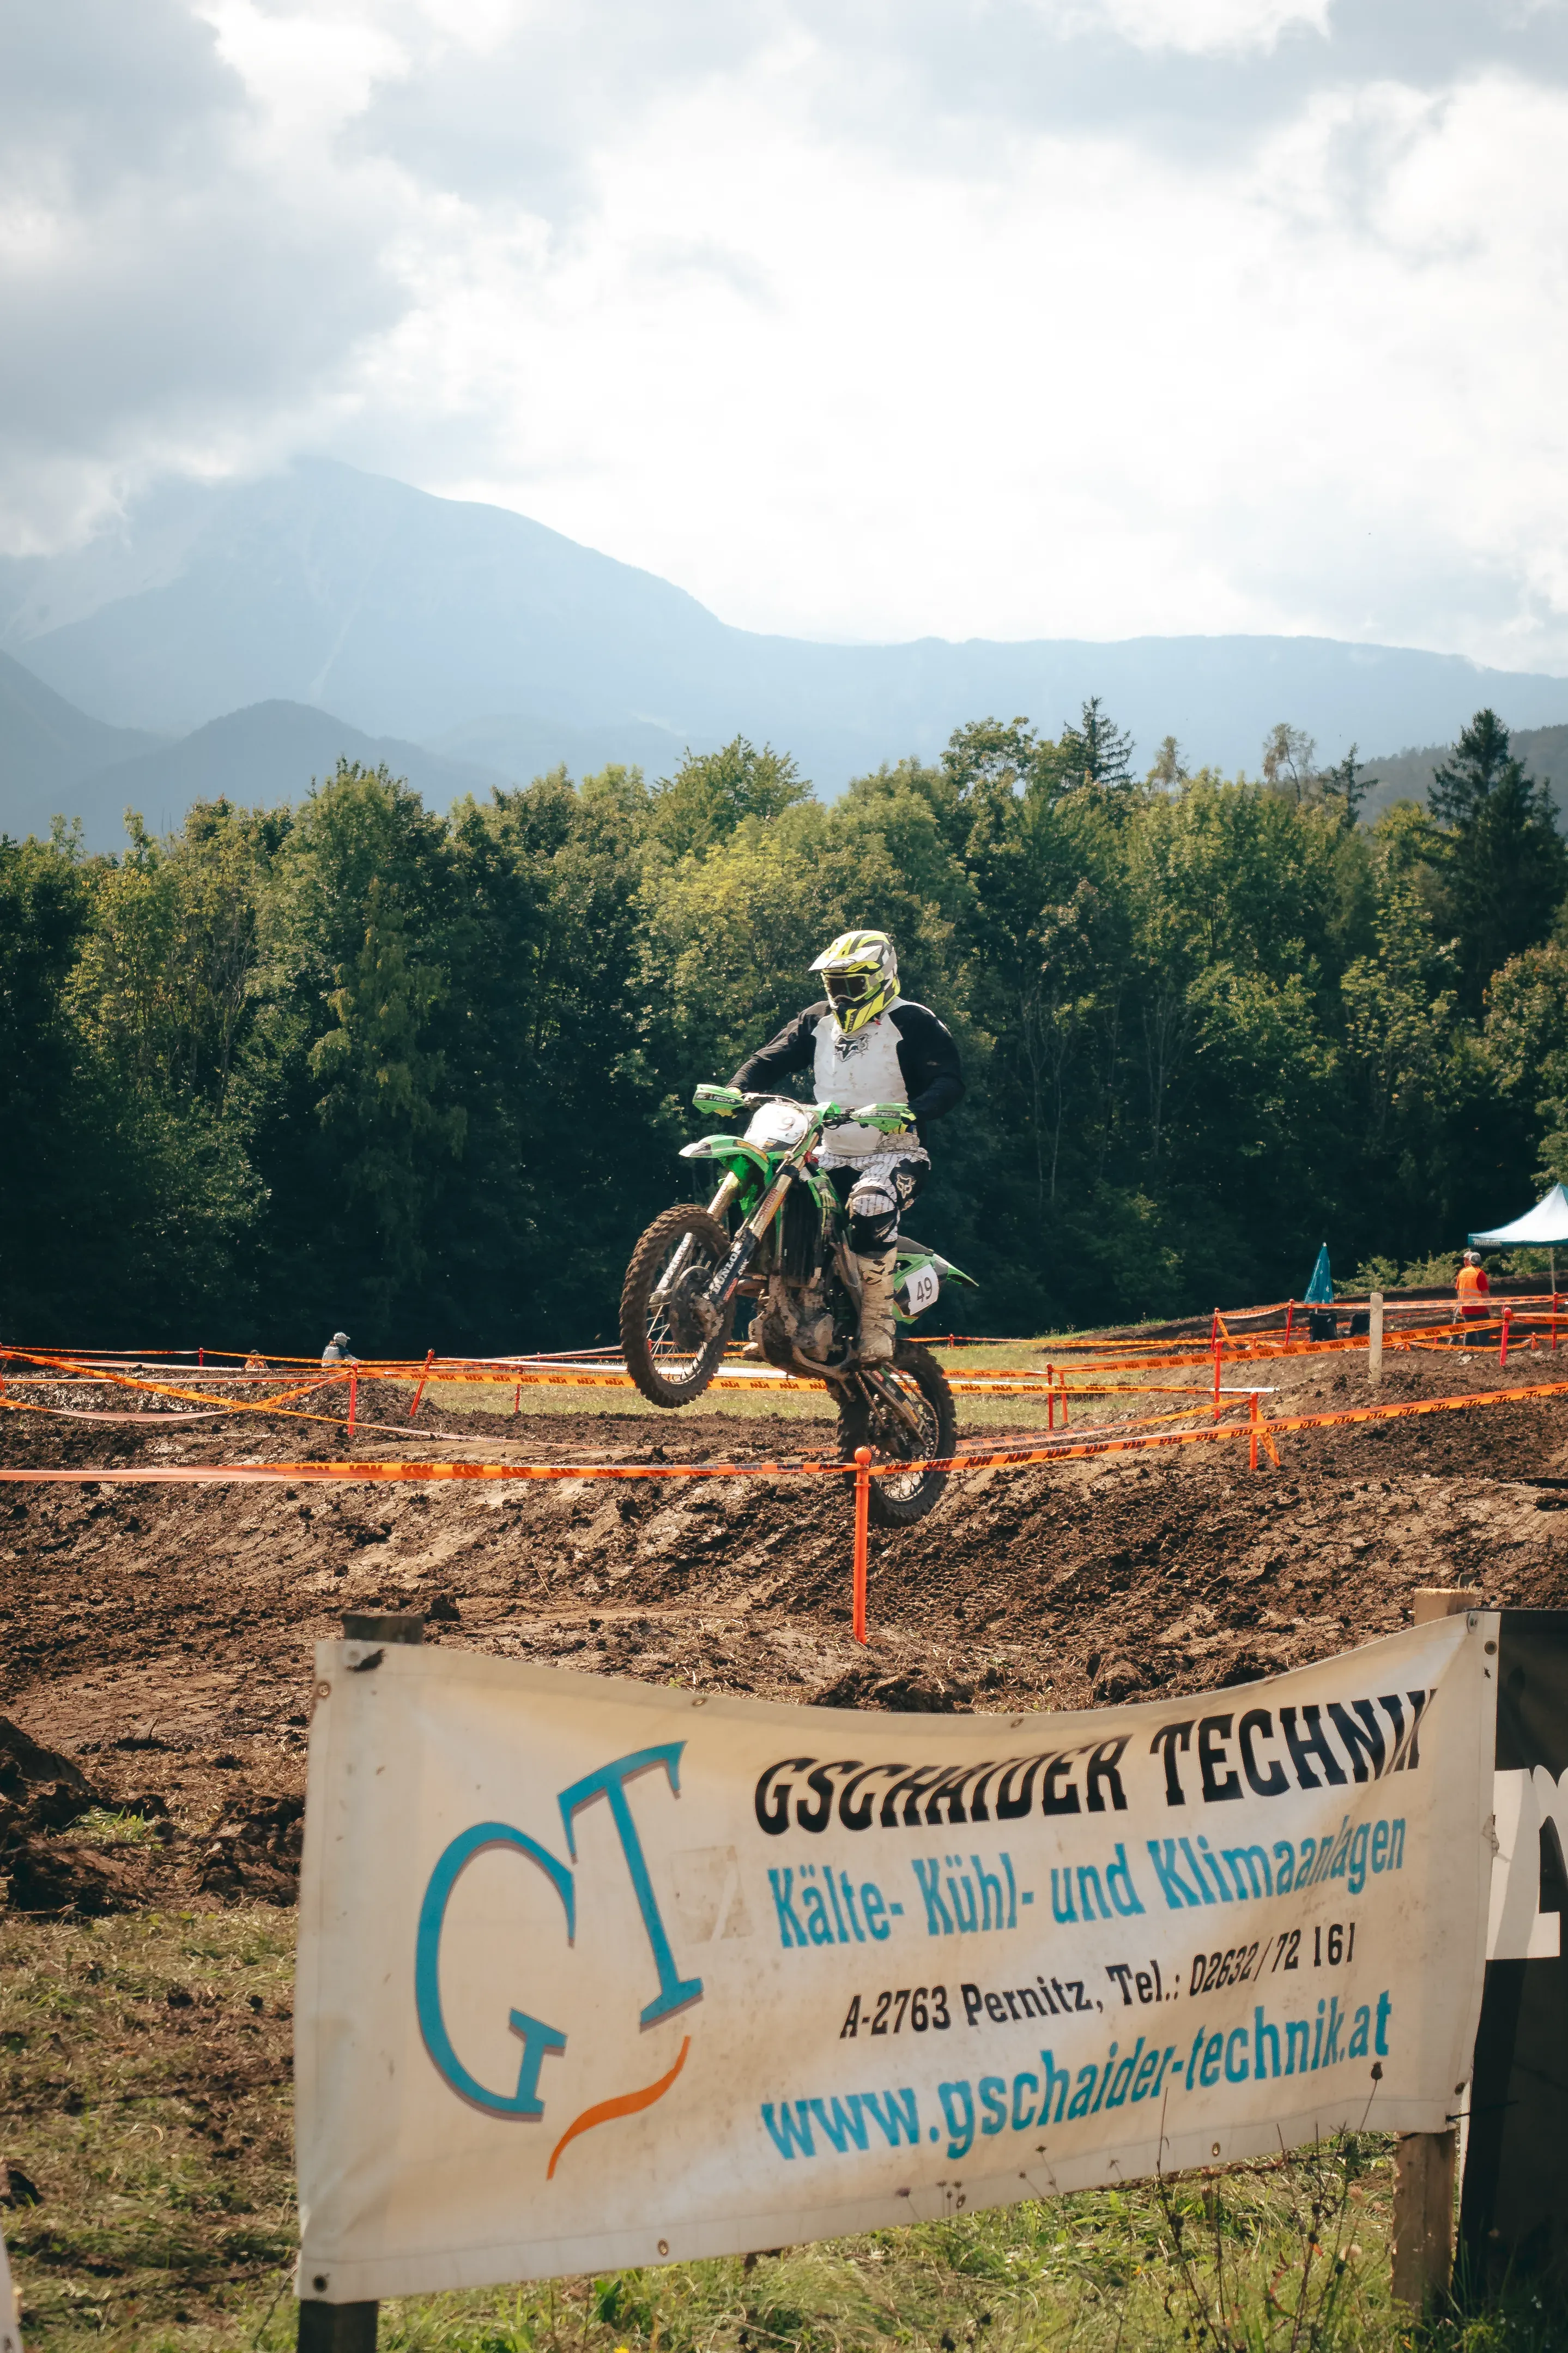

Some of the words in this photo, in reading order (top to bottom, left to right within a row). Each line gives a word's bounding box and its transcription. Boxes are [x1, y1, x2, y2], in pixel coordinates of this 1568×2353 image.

[712, 1241, 742, 1294] DUNLOP
[917, 1277, 933, 1302] 49
[755, 1734, 1133, 1836] GSCHAIDER
[414, 1740, 704, 2123] GT
[767, 1863, 905, 1949] Kälte-
[911, 1851, 1034, 1936] Kühl-
[1050, 1842, 1146, 1924] und
[1146, 1814, 1406, 1909] Klimaanlagen
[839, 1984, 952, 2040] A-2763
[960, 1975, 1104, 2026] Pernitz,
[1105, 1959, 1181, 2005] Tel.:
[1313, 1922, 1356, 1967] 161
[761, 1989, 1392, 2160] www.gschaider-technik.at
